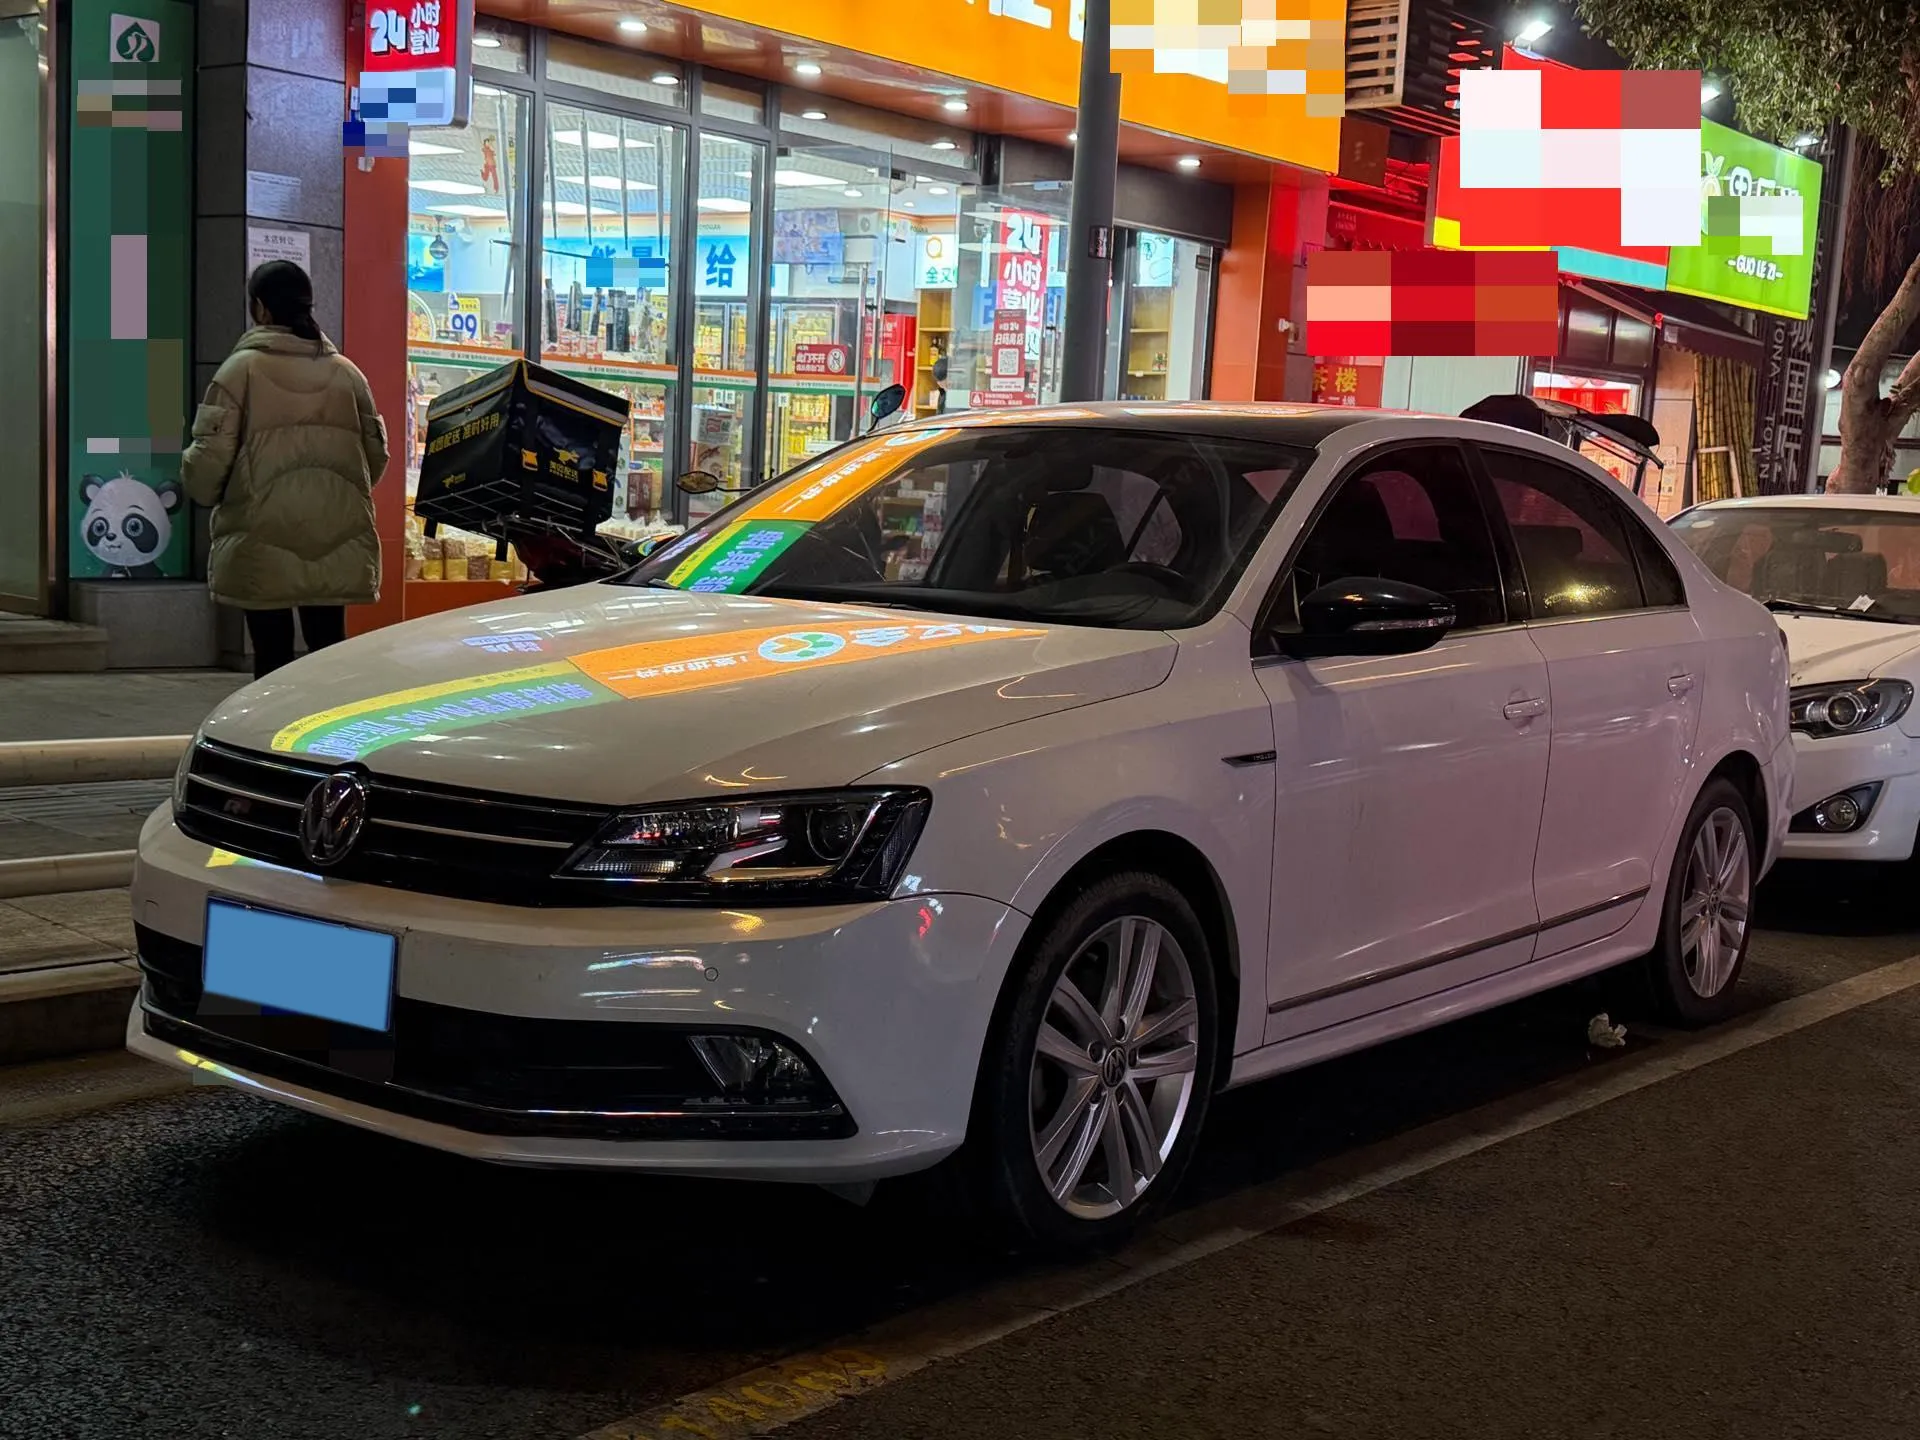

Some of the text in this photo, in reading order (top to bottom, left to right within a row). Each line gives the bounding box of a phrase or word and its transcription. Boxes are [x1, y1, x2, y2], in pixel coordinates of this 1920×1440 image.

[370, 8, 407, 54] 24
[411, 1, 440, 28] 小时
[411, 27, 440, 55] 营业
[1006, 213, 1041, 255] 24
[925, 266, 958, 284] 全又
[1003, 255, 1042, 291] 小时
[1003, 288, 1040, 322] 营业
